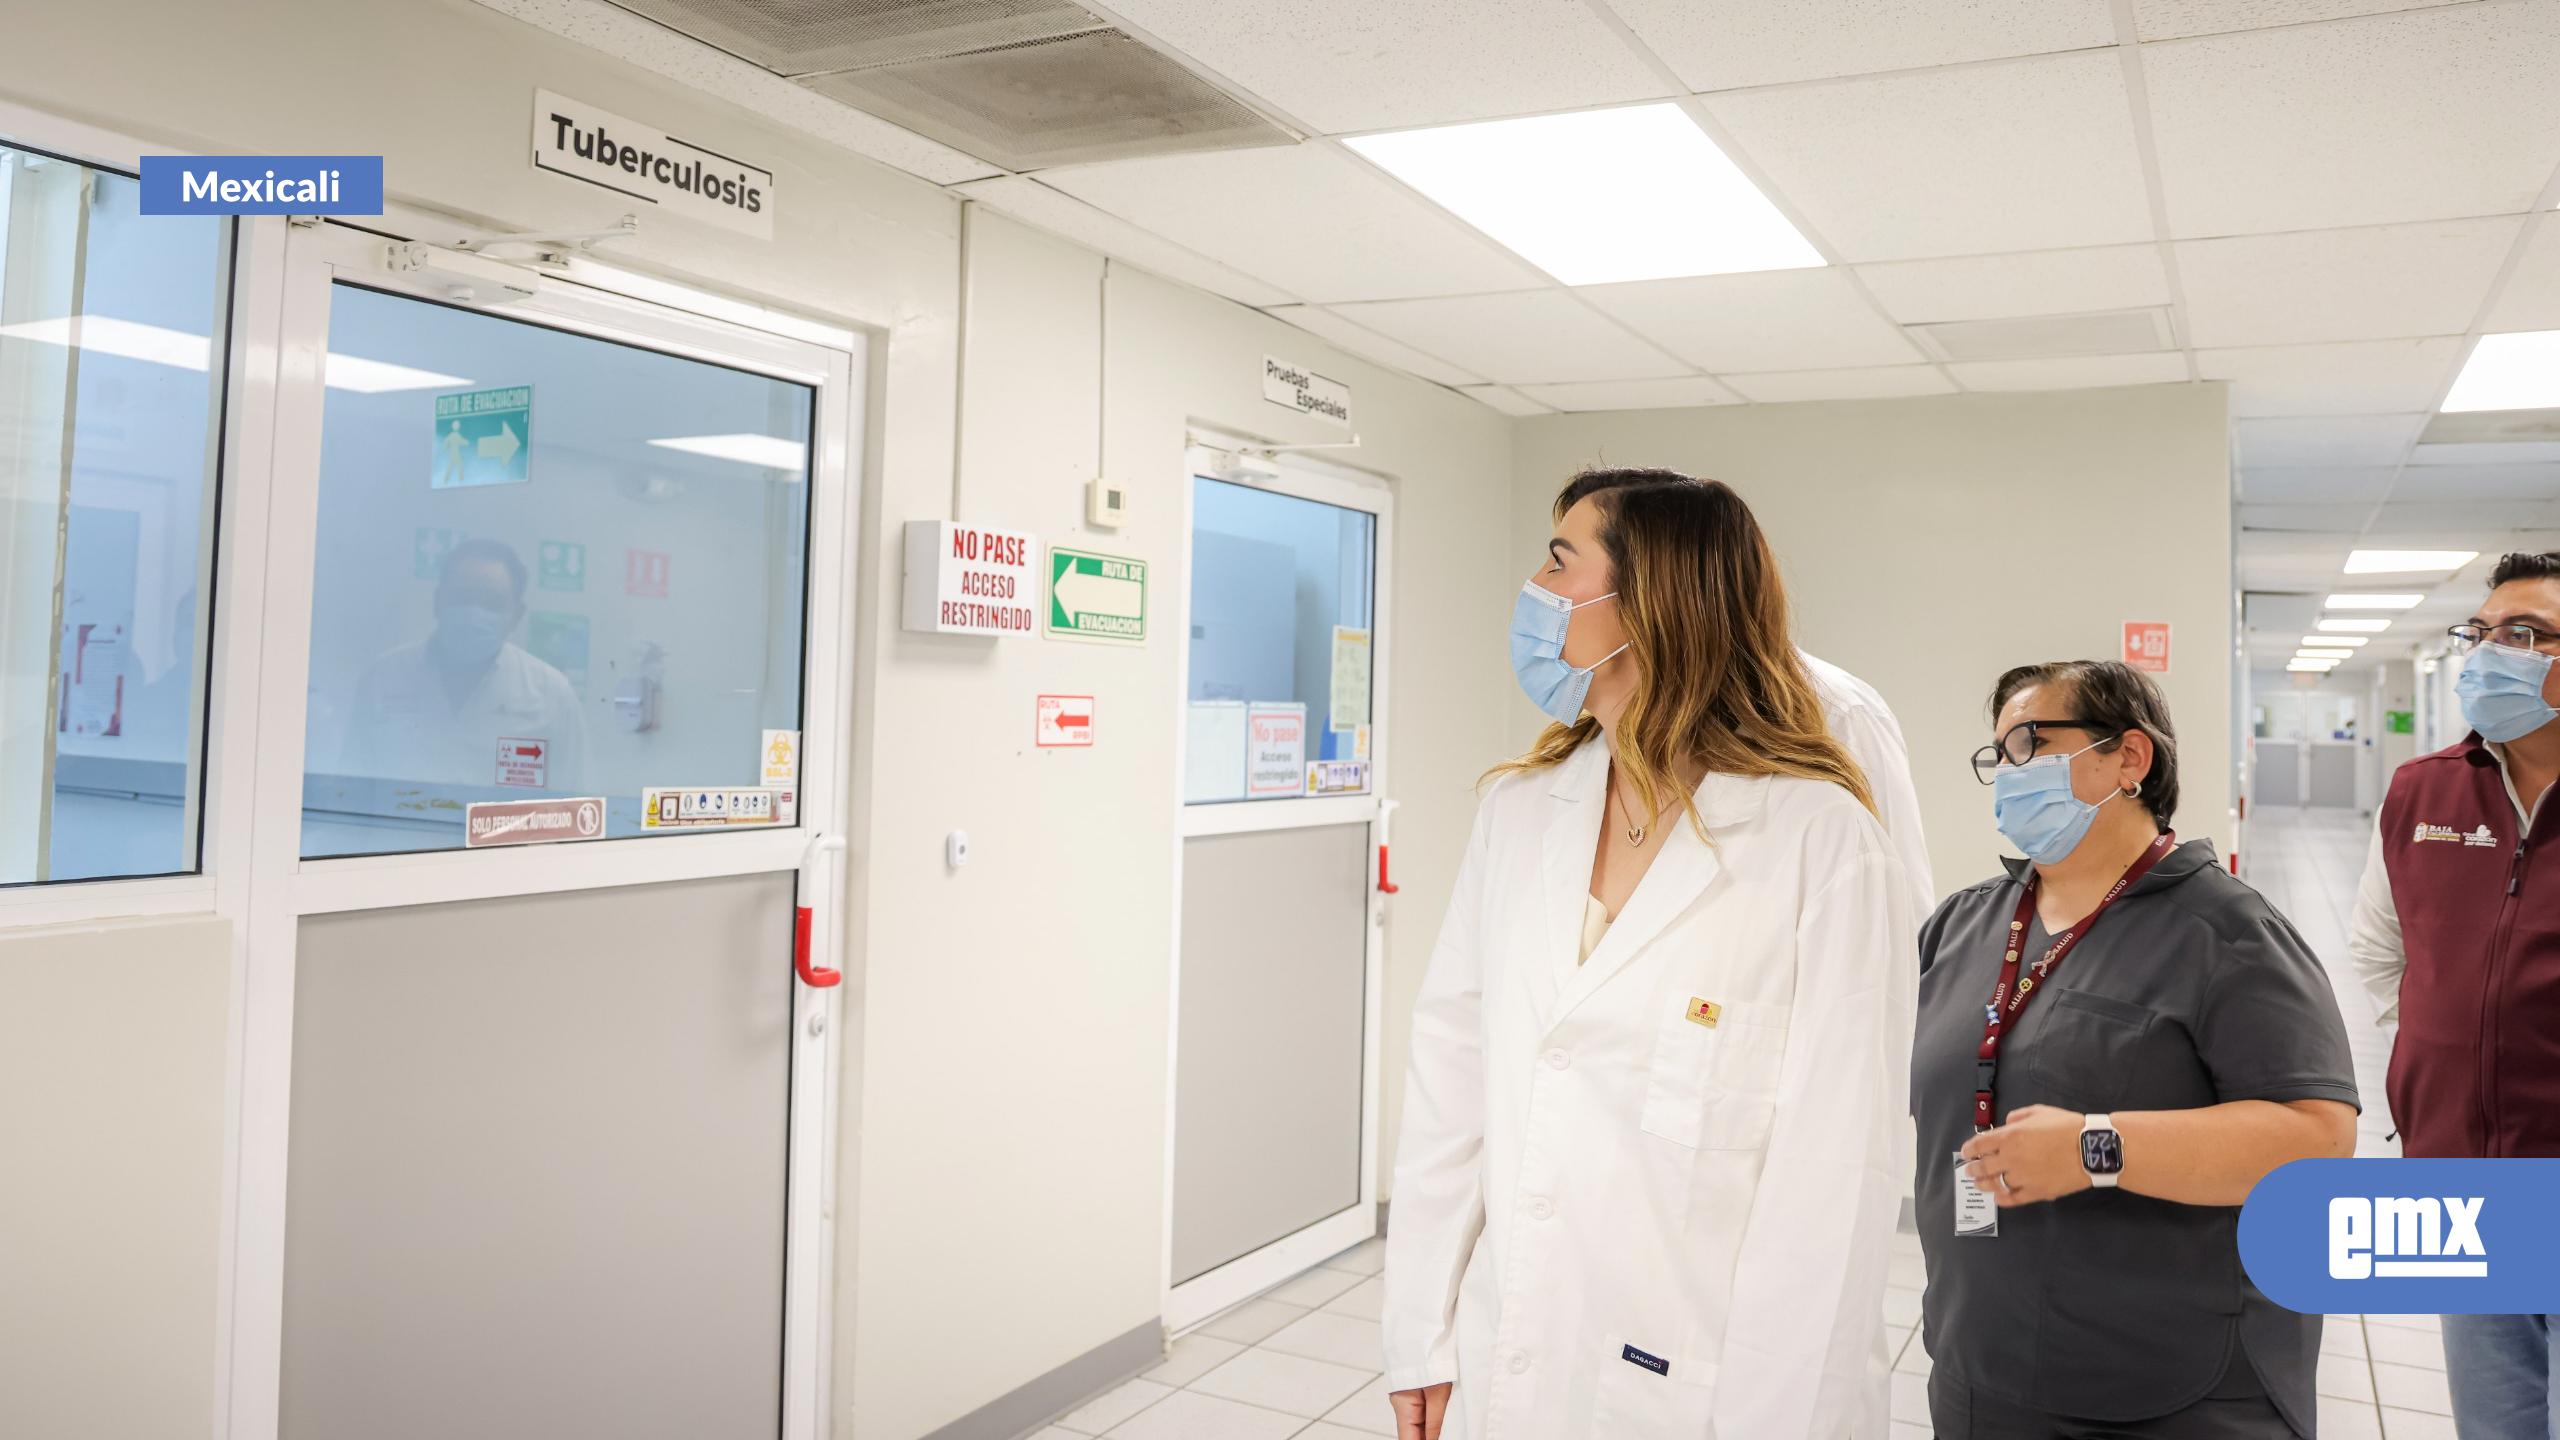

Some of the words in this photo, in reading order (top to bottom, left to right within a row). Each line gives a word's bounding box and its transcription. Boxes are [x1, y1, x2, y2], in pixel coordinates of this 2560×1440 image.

[551, 112, 761, 213] Tuberculosis
[1267, 360, 1309, 389] Pruebas
[1297, 388, 1346, 420] Especiales
[953, 528, 977, 560] NO
[983, 533, 1025, 566] PASE
[1102, 561, 1129, 579] RUTA
[1129, 565, 1143, 581] DE
[962, 571, 1015, 599] ACCESO
[941, 600, 1032, 631] RESTRINGIDO
[1078, 613, 1142, 634] EVACUACION
[1040, 700, 1060, 709] RUTA
[1252, 722, 1270, 742] No
[1273, 727, 1298, 747] pase
[1260, 751, 1292, 763] Acceso
[1253, 769, 1299, 782] restringido
[472, 817, 492, 834] SOLO
[529, 811, 572, 830] AUTORIZADO
[2104, 879, 2128, 902] SALUD
